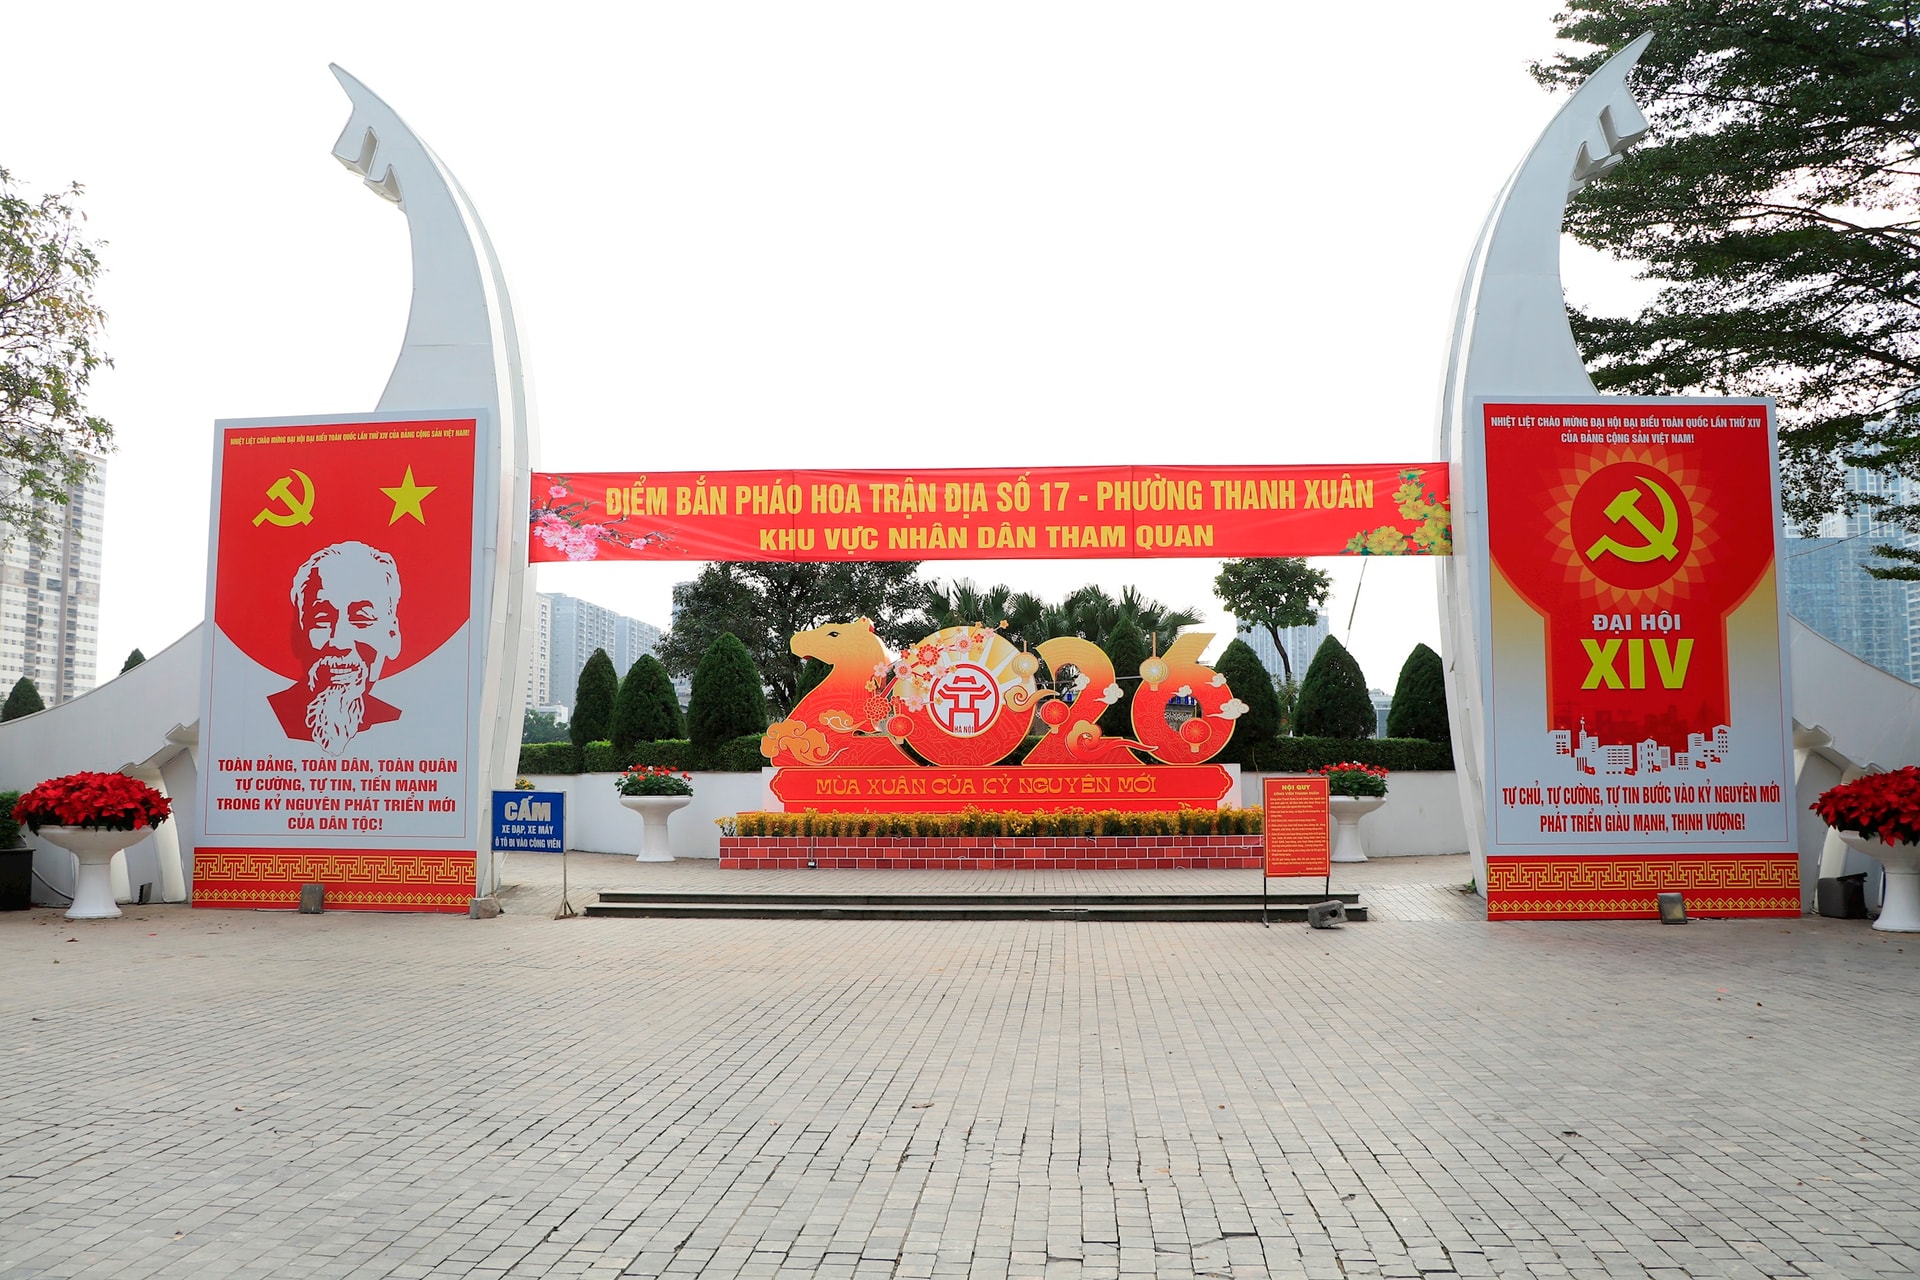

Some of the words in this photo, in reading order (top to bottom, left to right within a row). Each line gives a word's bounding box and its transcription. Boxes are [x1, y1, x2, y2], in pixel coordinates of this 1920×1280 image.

[1491, 415, 1516, 428] NHIỆT
[1518, 415, 1535, 428] LIỆT
[1537, 416, 1560, 426] CHÀO
[1563, 415, 1588, 427] MỪNG
[1590, 418, 1605, 429] ĐẠI
[1607, 416, 1621, 429] HỘI
[1624, 418, 1638, 429] ĐẠI
[1640, 414, 1659, 427] BIỂU
[1661, 416, 1684, 427] TOÀN
[1686, 415, 1708, 428] QUỐC
[1729, 416, 1746, 428] THỨ
[1748, 418, 1760, 428] XIV
[389, 429, 399, 439] CỦA
[400, 428, 415, 438] ĐẢNG
[416, 430, 430, 439] CỘNG
[431, 428, 442, 437] SẢN
[443, 429, 454, 439] VIỆT
[455, 429, 470, 437] NAM!
[1561, 430, 1578, 443] CỦA
[1580, 430, 1604, 443] ĐẢNG
[1606, 432, 1629, 445] CỘNG
[1632, 430, 1649, 443] SẢN
[1652, 432, 1669, 445] VIỆT
[1672, 434, 1694, 443] NAM!
[606, 475, 668, 515] ĐIỂM
[676, 475, 727, 515] BẮN
[736, 479, 802, 514] PHÁO
[811, 484, 861, 514] HOA
[869, 477, 936, 519] TRẬN
[944, 482, 988, 519] ĐỊA
[996, 472, 1031, 512] SỐ
[1040, 482, 1070, 511] 17
[1097, 473, 1202, 511] PHƯỜNG
[1211, 480, 1295, 510] THANH
[1304, 473, 1374, 509] XUÂN
[760, 528, 815, 550] KHU
[824, 526, 879, 554] VỰC
[889, 522, 968, 549] NHÂN
[978, 522, 1036, 548] DÂN
[1046, 525, 1126, 548] THAM
[1136, 525, 1213, 550] QUAN
[1592, 614, 1632, 634] ĐẠI
[1641, 610, 1680, 634] HỘI
[1580, 639, 1694, 689] XIV
[218, 757, 252, 772] TOÀN
[256, 754, 297, 773] ĐẢNG,
[302, 757, 336, 772] TOÀN
[342, 757, 373, 773] DÂN,
[378, 757, 414, 772] TOÀN
[419, 757, 457, 773] QUÂN
[235, 777, 253, 793] TỰ
[256, 776, 305, 792] CƯỜNG,
[310, 778, 328, 793] TỰ
[330, 779, 356, 792] TIN,
[361, 775, 391, 791] TIẾN
[395, 780, 437, 794] MẠNH
[816, 775, 861, 794] MÙA
[867, 775, 926, 795] XUÂN
[932, 774, 977, 794] CỦA
[982, 774, 1014, 794] KỶ
[1019, 773, 1111, 794] NGUYÊN
[1118, 772, 1156, 792] MỚI
[1502, 786, 1517, 809] TỰ
[1519, 780, 1544, 807] CHỦ,
[1547, 786, 1561, 808] TỰ
[1564, 782, 1603, 806] CƯỜNG,
[1606, 785, 1620, 808] TỰ
[1622, 787, 1639, 804] TIN
[1643, 781, 1671, 803] BƯỚC
[1674, 782, 1695, 803] VÀO
[1698, 778, 1711, 803] KỶ
[1715, 782, 1757, 802] NGUYÊN
[1760, 780, 1781, 802] MỚI
[217, 798, 260, 810] TRONG
[264, 794, 281, 810] KỶ
[285, 796, 340, 811] NGUYÊN
[344, 797, 380, 811] PHÁT
[384, 795, 424, 812] TRIỂN
[428, 796, 456, 812] MỚI
[505, 795, 551, 821] CẤM
[288, 813, 315, 829] CỦA
[320, 815, 347, 830] DÂN
[352, 816, 382, 833] TỘC!
[502, 825, 510, 833] XE
[512, 825, 526, 836] ĐẠP,
[528, 825, 536, 834] XE
[538, 824, 554, 834] MÁY
[1540, 811, 1568, 832] PHÁT
[1571, 808, 1602, 832] TRIỂN
[1605, 811, 1630, 832] GIÀU
[1633, 814, 1669, 835] MẠNH,
[1672, 814, 1703, 834] THỊNH
[1706, 812, 1745, 834] VƯỢNG!
[495, 836, 500, 846] Ô
[501, 836, 508, 847] TÔ
[516, 837, 528, 847] VÀO
[529, 837, 545, 848] CÔNG
[547, 837, 561, 848] VIÊN
